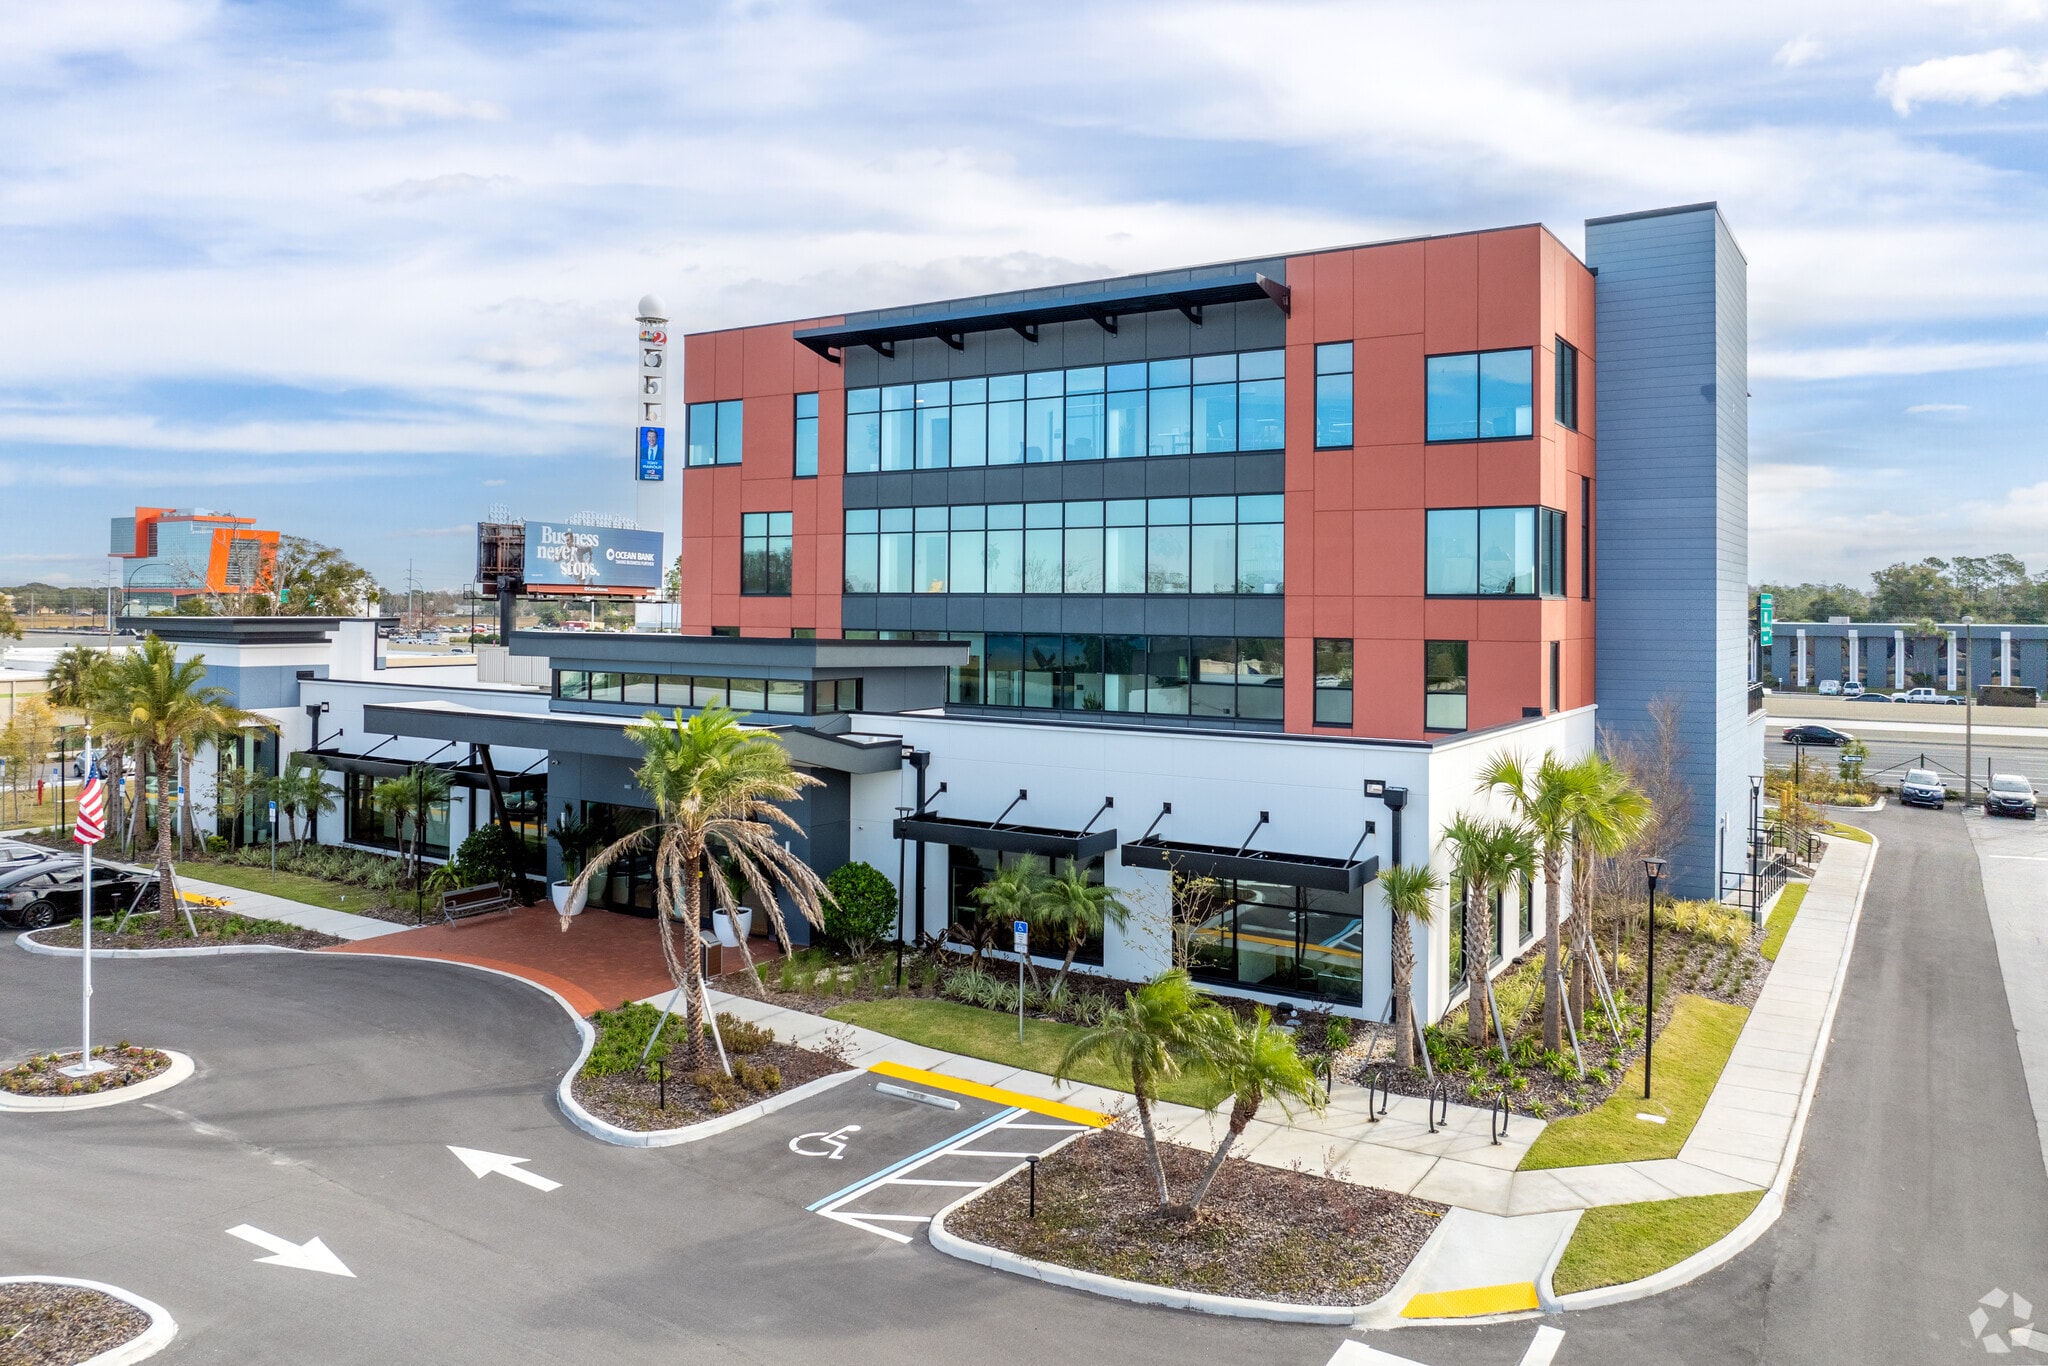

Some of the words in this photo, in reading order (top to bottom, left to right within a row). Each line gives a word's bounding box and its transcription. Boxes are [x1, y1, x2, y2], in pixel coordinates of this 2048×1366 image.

[653, 331, 665, 345] 2
[541, 526, 600, 547] Busness
[536, 545, 578, 561] never
[615, 551, 637, 560] OCEAN
[638, 552, 654, 562] BANK
[560, 559, 601, 580] stops.
